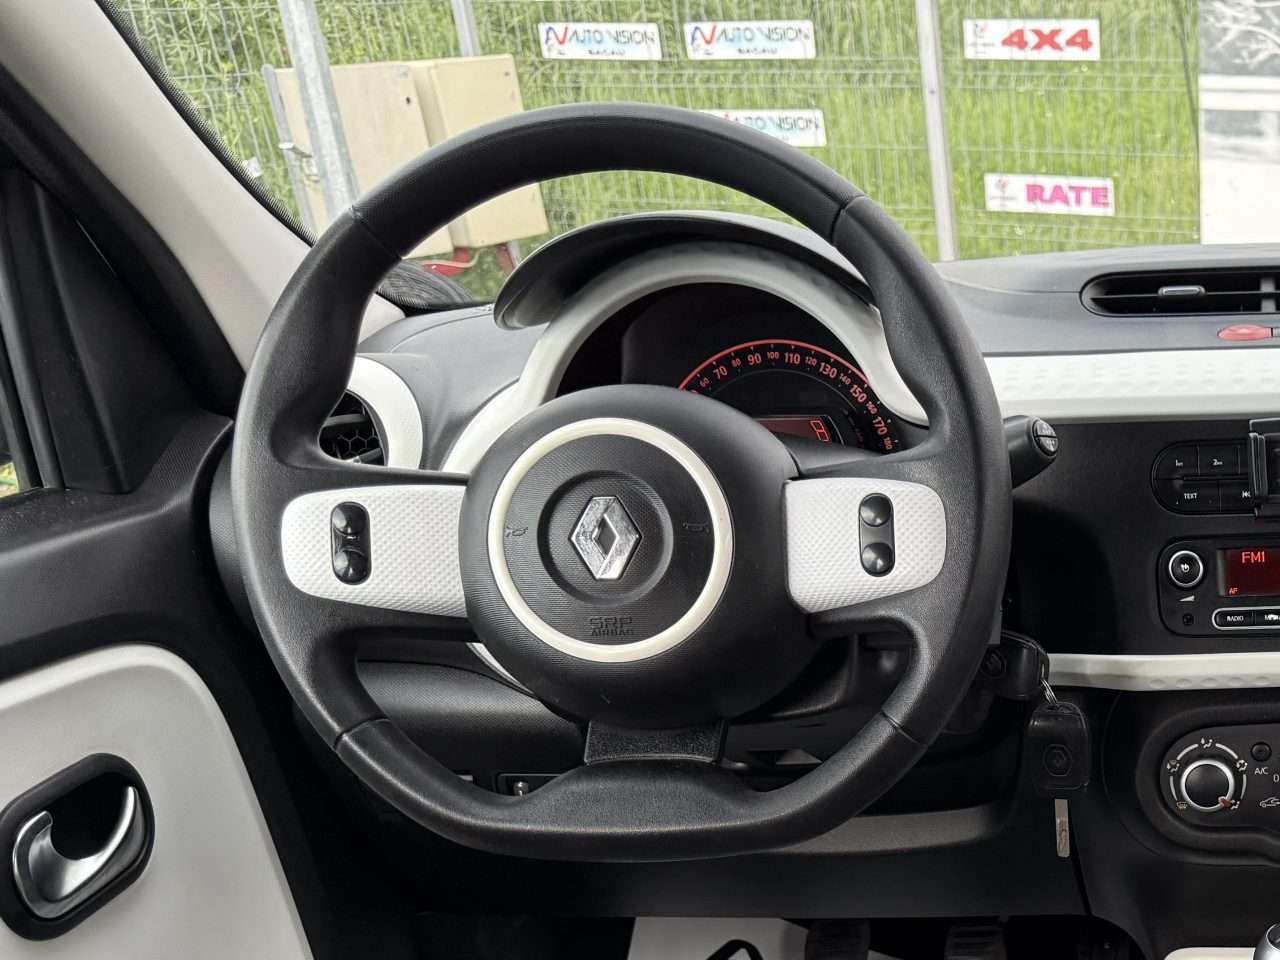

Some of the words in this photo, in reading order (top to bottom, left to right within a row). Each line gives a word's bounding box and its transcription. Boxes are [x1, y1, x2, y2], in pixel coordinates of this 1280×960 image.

[569, 29, 604, 44] AUTO
[606, 28, 655, 45] VISION
[717, 27, 754, 42] AUTO
[1001, 28, 1093, 51] 4X4
[768, 115, 818, 131] VISION
[1026, 183, 1109, 209] RATE
[713, 366, 728, 379] 70
[731, 357, 742, 368] 80
[747, 353, 762, 365] 90
[767, 351, 780, 359] 100
[784, 352, 801, 365] 110
[805, 356, 817, 366] 120
[819, 362, 838, 379] 130
[840, 373, 852, 385] 140
[849, 384, 868, 403] 150
[866, 401, 878, 415] 160
[873, 416, 888, 436] 170
[884, 437, 893, 450] 180
[1227, 614, 1245, 622] RADIO
[1254, 766, 1270, 775] A/C
